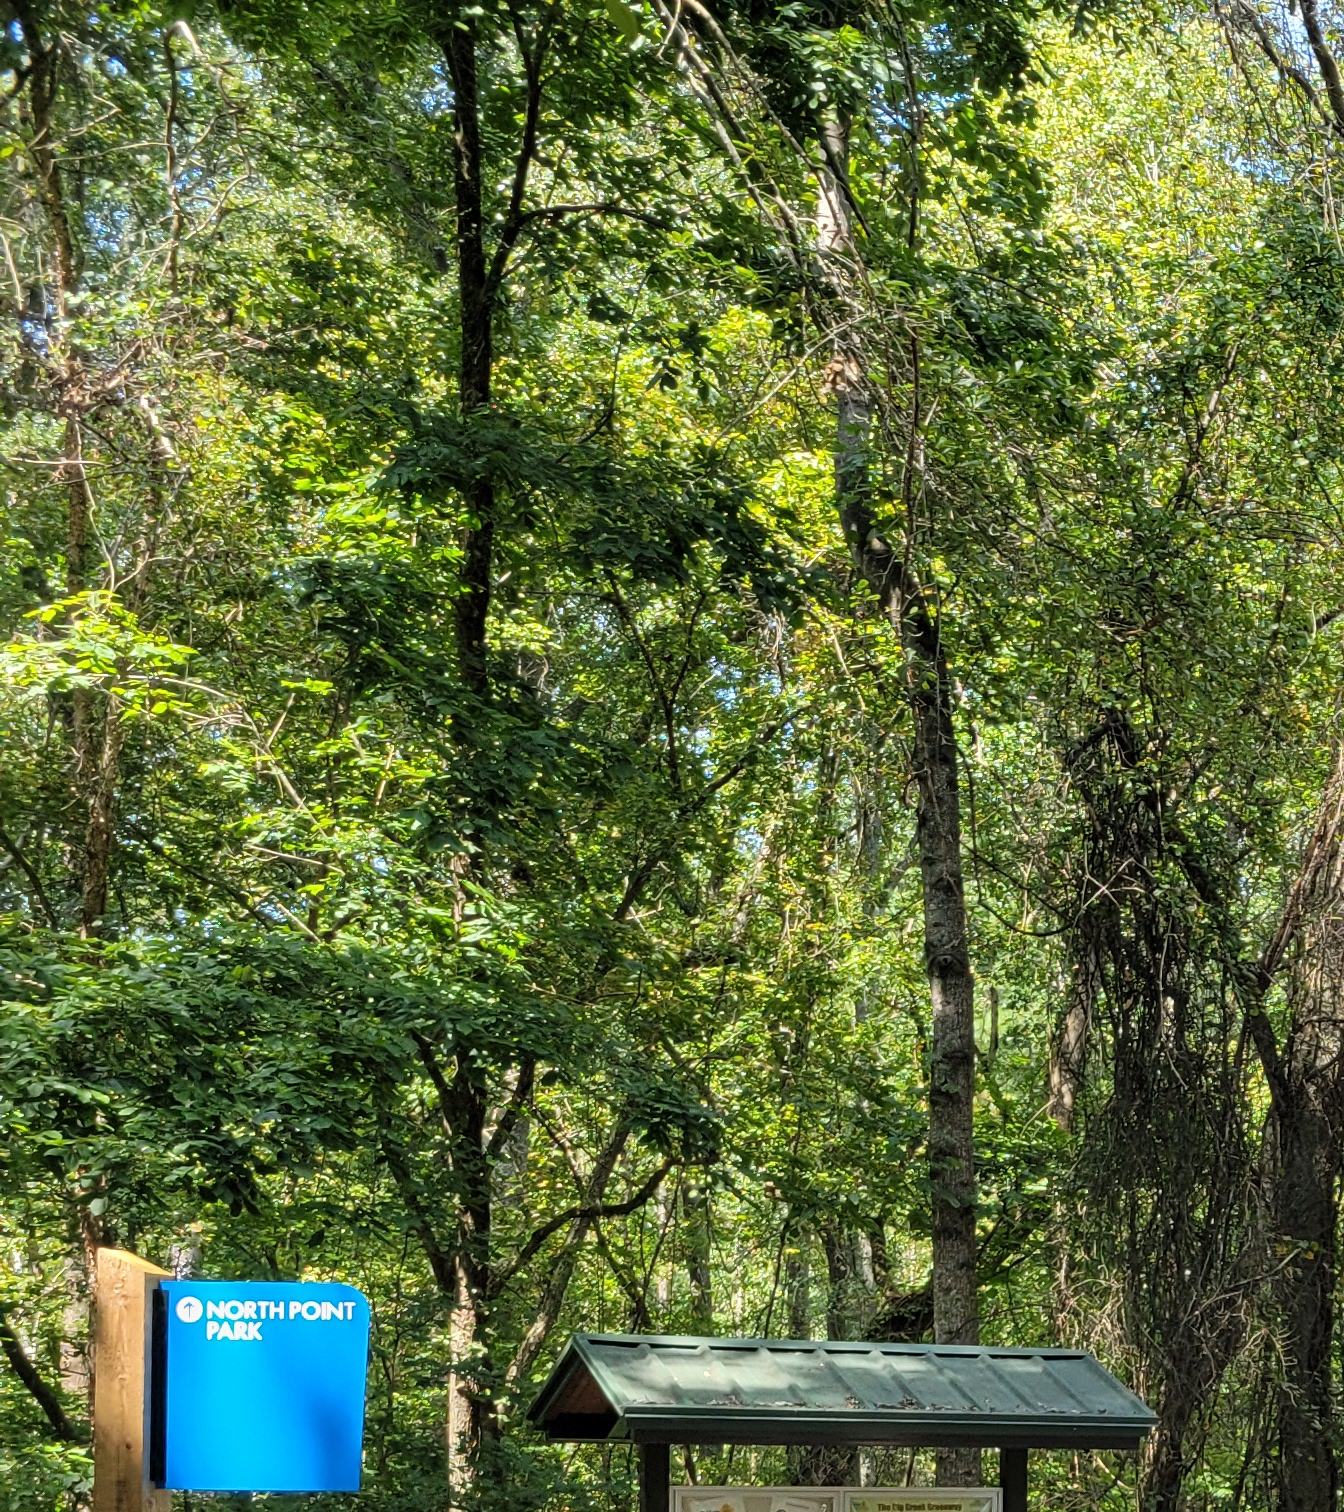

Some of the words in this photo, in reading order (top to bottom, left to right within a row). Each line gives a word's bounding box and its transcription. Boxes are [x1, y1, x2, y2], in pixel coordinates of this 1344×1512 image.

[206, 1300, 285, 1320] NORTH
[288, 1300, 357, 1321] POINT
[206, 1321, 263, 1341] PARK
